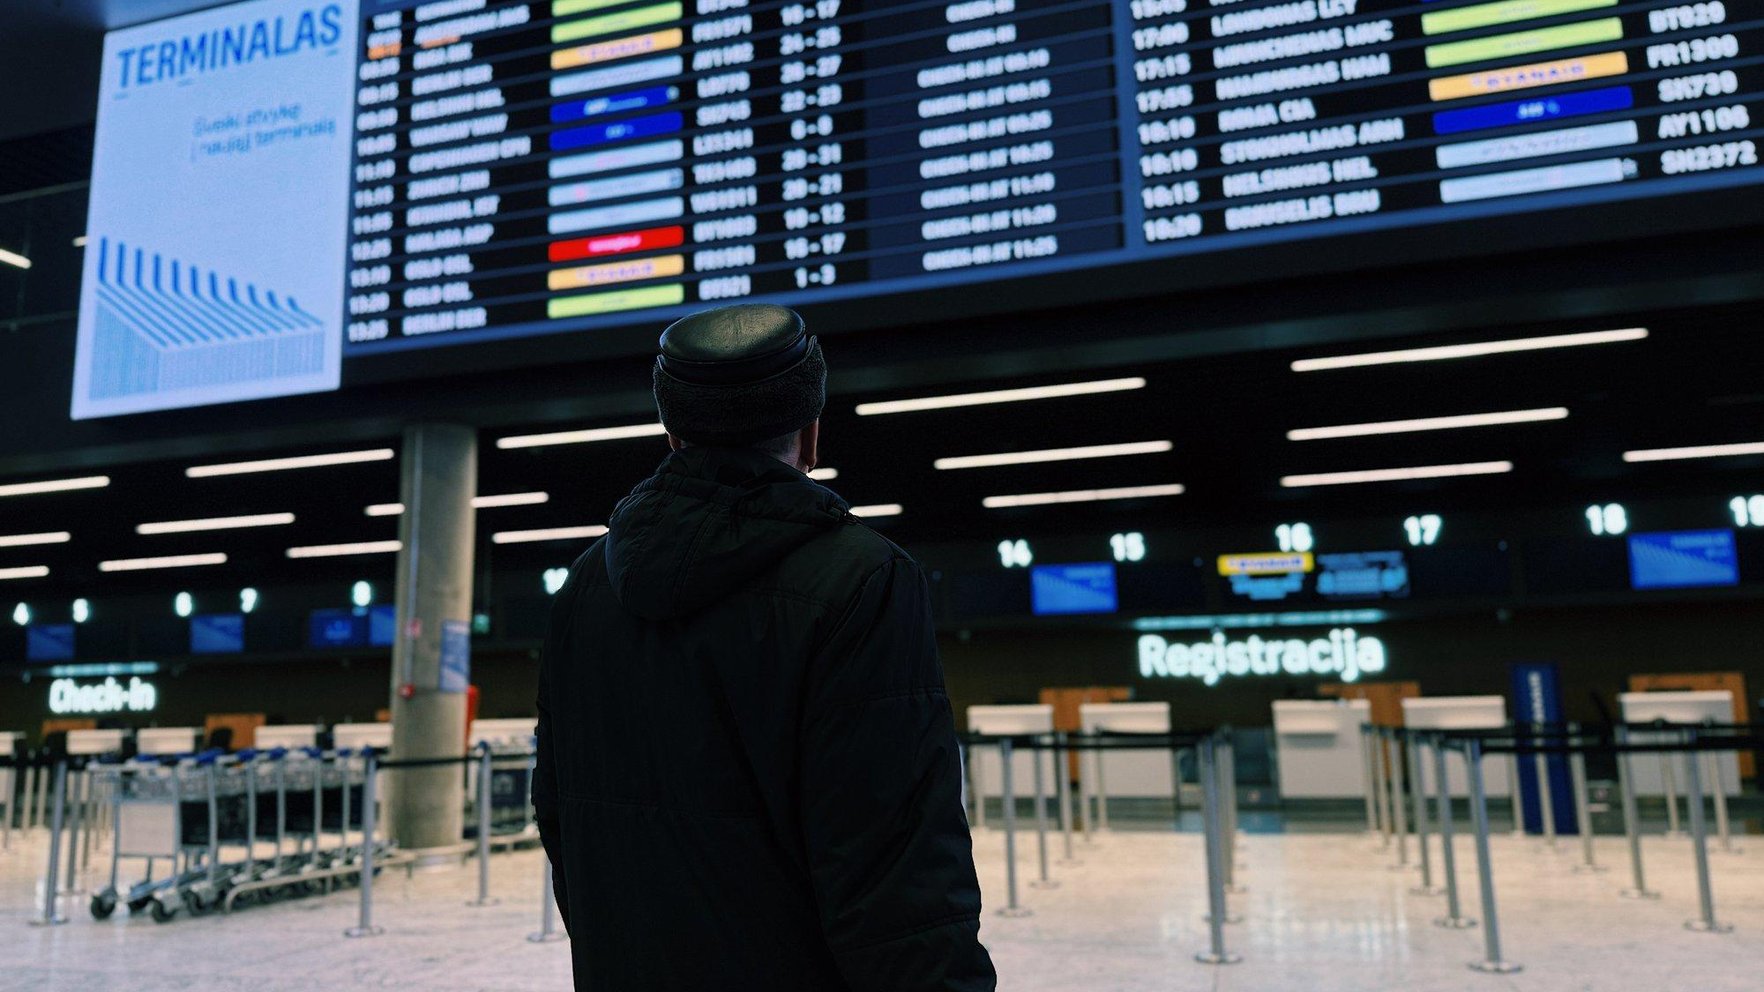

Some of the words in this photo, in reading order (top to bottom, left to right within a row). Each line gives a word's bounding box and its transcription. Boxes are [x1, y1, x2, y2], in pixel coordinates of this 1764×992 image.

[117, 2, 343, 88] TERMINALAS
[1404, 515, 1441, 545] 17
[998, 540, 1032, 567] 14
[1110, 533, 1145, 561] 15
[241, 588, 257, 612] 7
[1138, 627, 1386, 686] Registracija
[49, 676, 156, 714] Check-in
